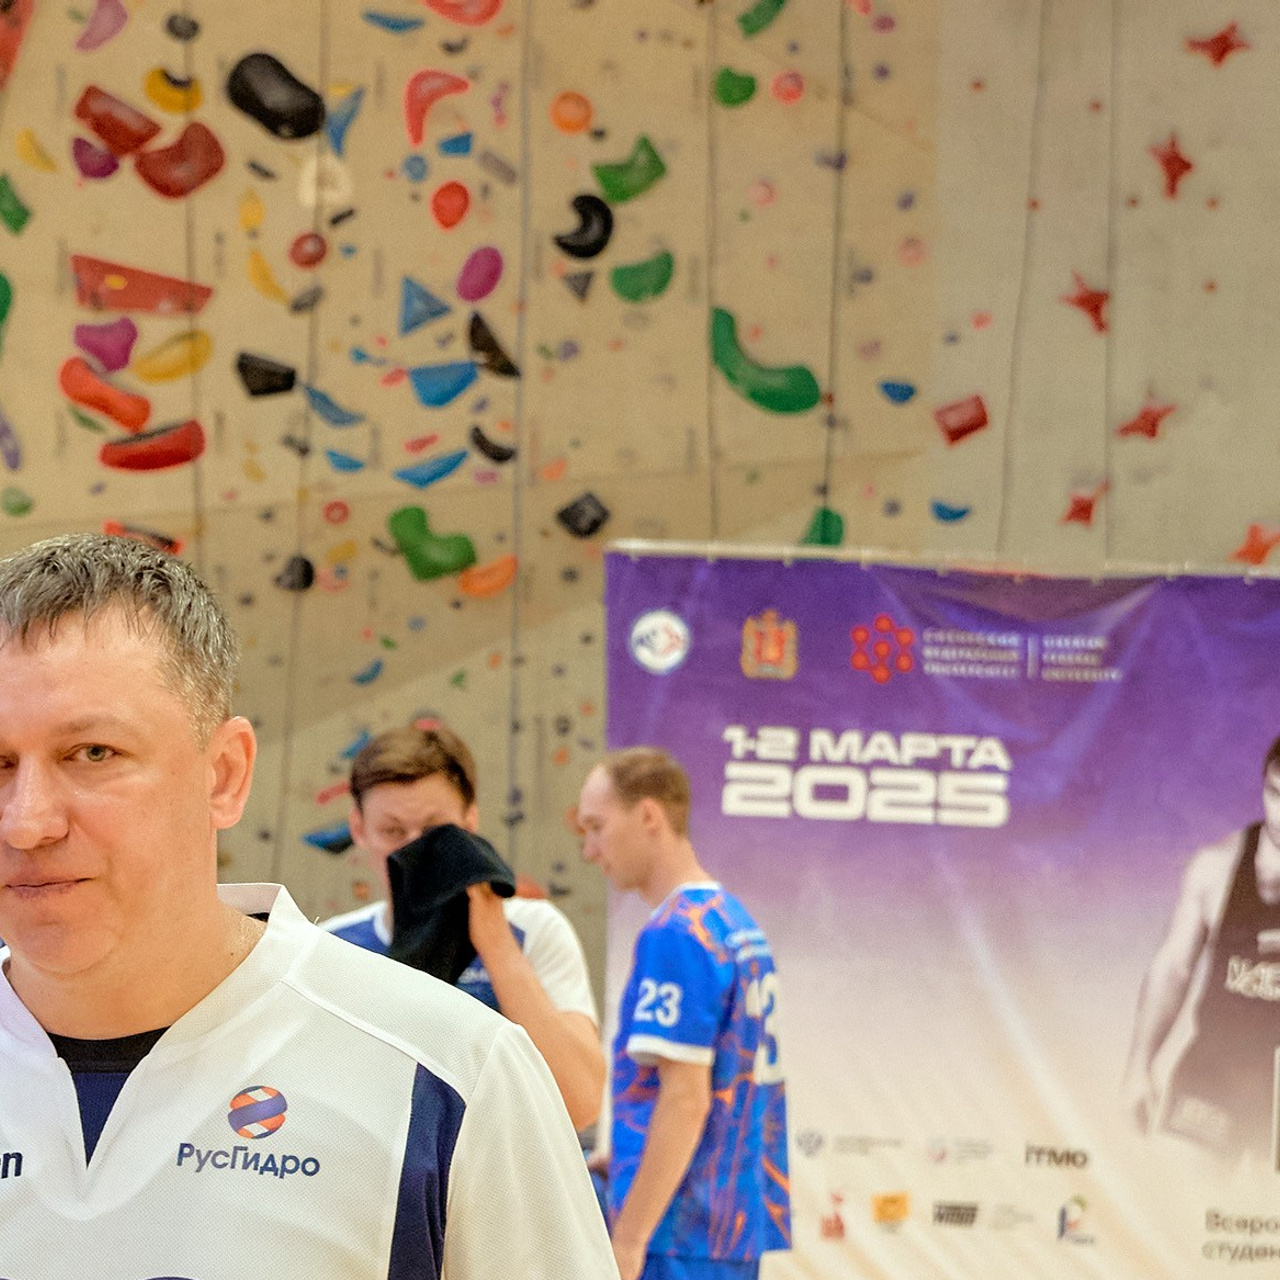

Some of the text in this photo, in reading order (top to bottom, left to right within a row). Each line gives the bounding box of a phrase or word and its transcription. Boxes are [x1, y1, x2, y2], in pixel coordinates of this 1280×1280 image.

[809, 728, 1012, 771] МАРТА
[721, 760, 1011, 828] 2025
[633, 977, 683, 1028] 23
[176, 1142, 321, 1179] РусГидро
